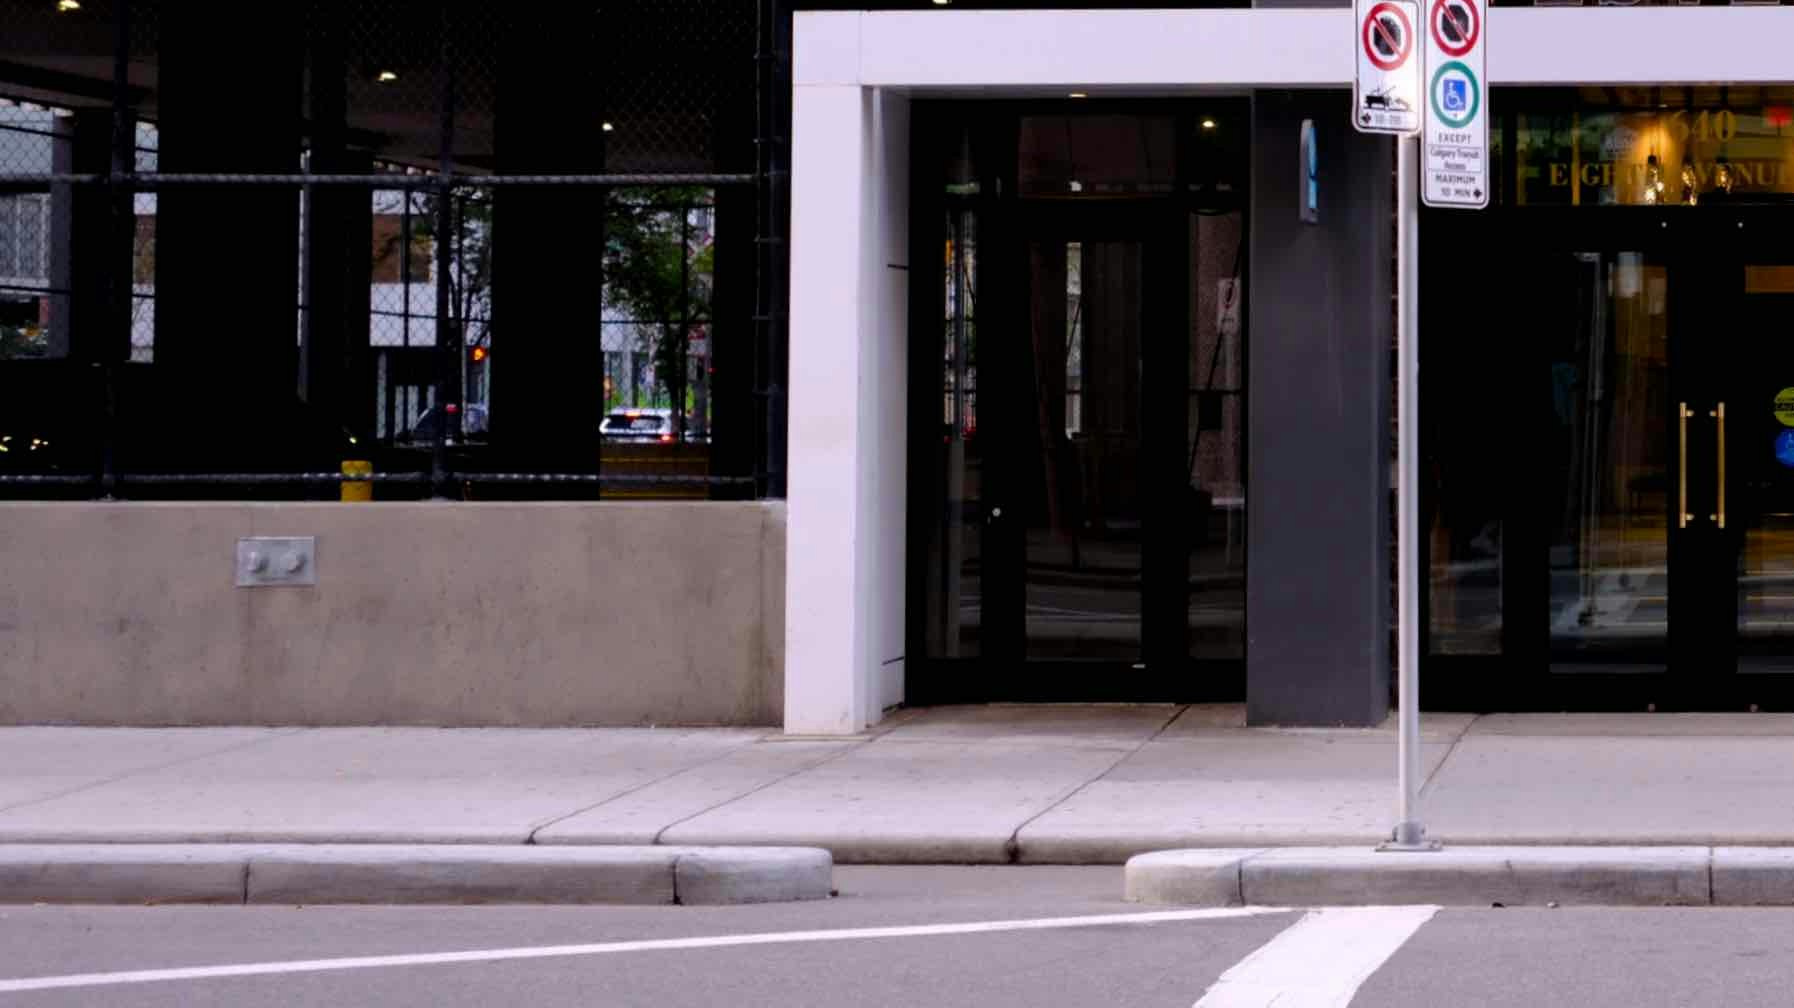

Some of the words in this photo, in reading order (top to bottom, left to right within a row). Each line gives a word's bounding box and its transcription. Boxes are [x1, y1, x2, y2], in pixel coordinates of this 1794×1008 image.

[1672, 109, 1737, 143] 640
[1438, 133, 1472, 144] EXCEPT
[1435, 175, 1476, 185] MAXIMUM
